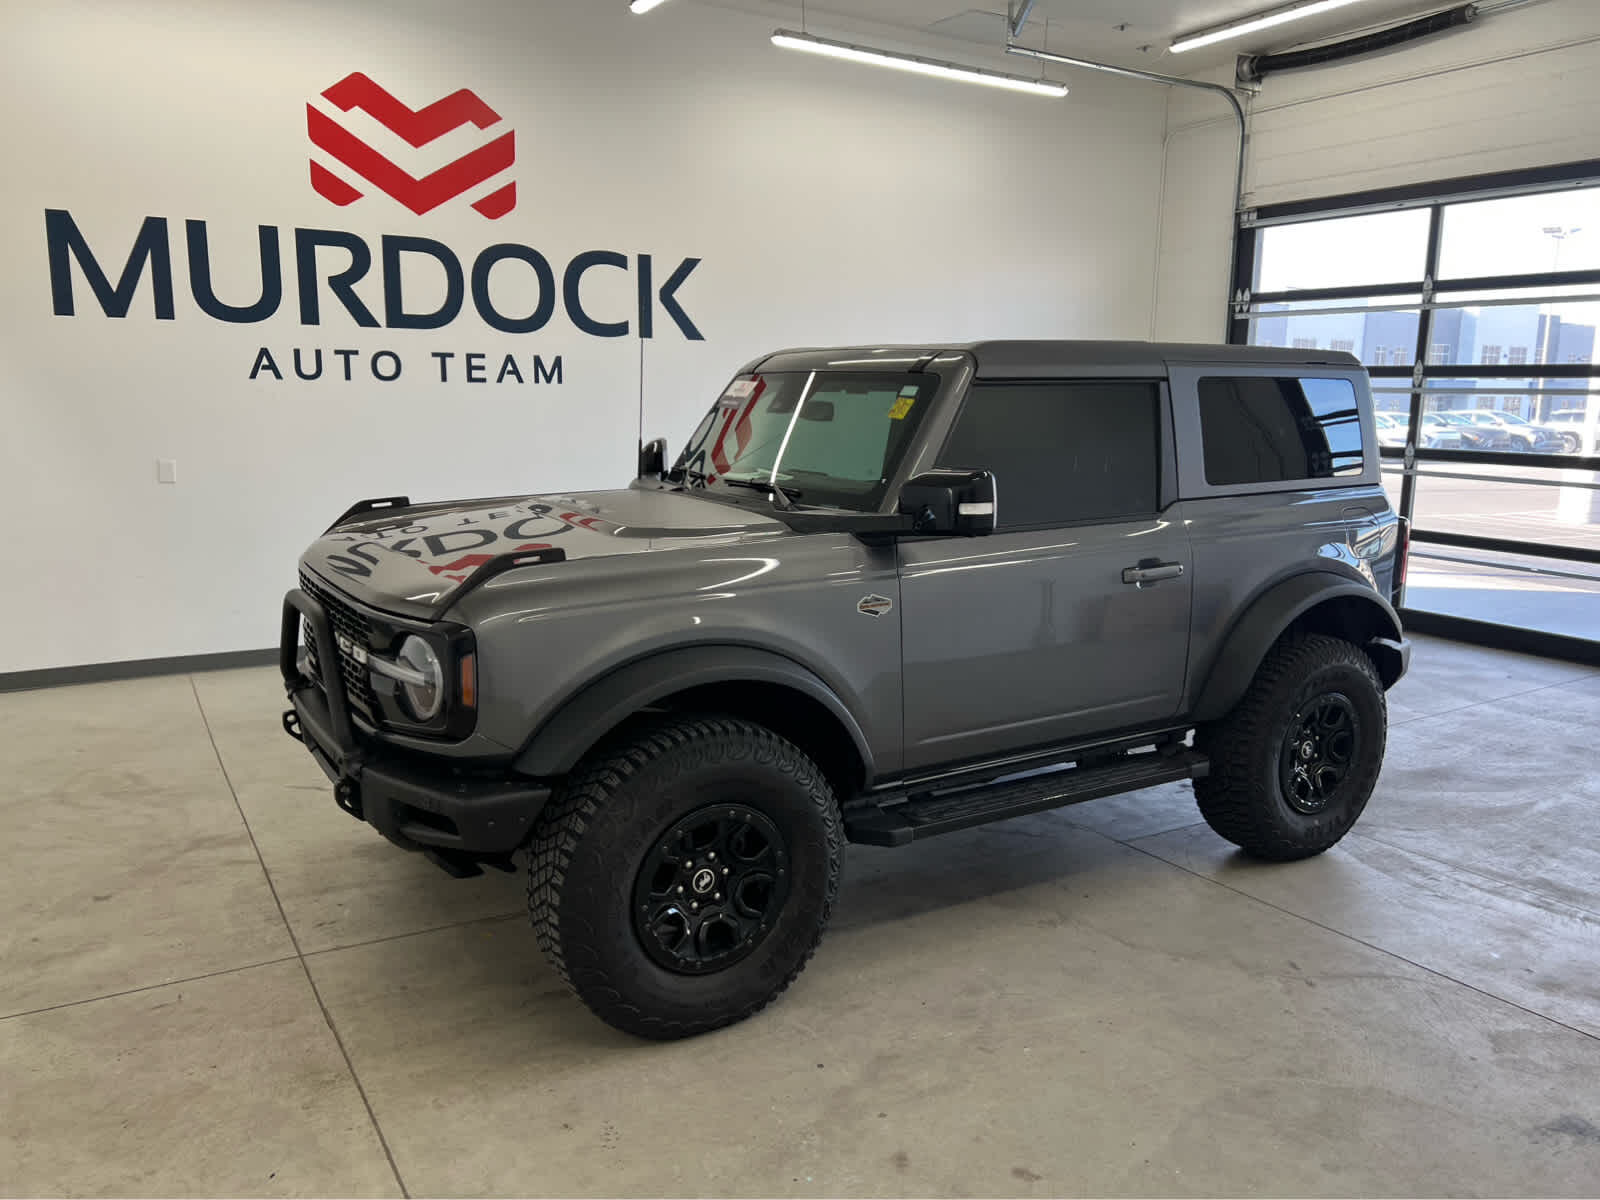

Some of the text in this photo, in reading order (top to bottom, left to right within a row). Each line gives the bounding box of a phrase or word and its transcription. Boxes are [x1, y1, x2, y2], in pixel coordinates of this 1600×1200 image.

[45, 208, 706, 341] MURDOCK
[249, 347, 563, 385] AUTO TEAM
